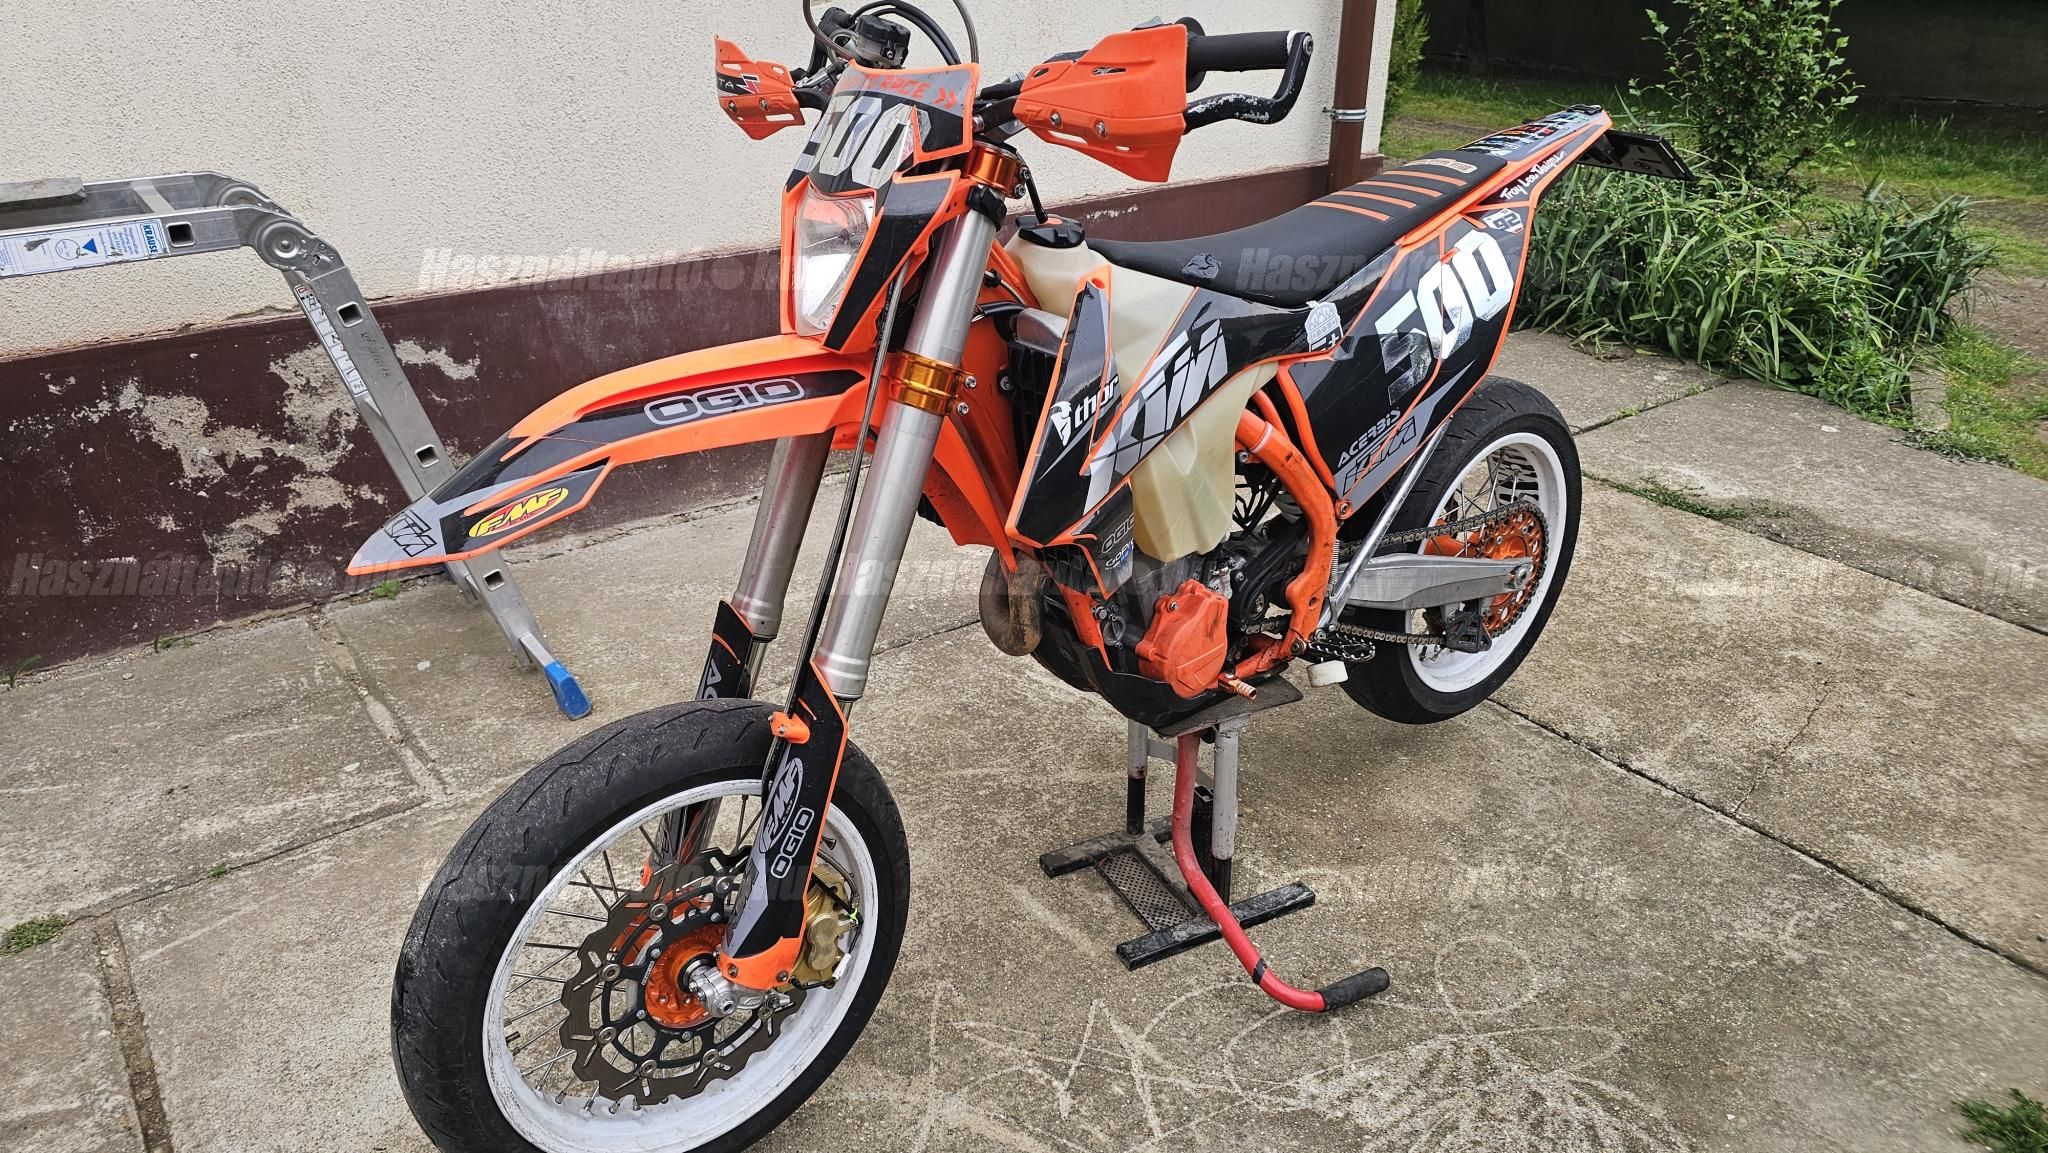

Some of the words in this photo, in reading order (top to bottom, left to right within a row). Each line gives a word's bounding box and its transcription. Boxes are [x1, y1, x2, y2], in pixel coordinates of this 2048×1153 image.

[1499, 184, 1529, 200] Troy
[143, 224, 157, 254] KRAUSE
[1492, 211, 1522, 230] 92
[1374, 229, 1515, 406] 500
[644, 377, 805, 426] OGIO
[1074, 374, 1120, 430] thor
[474, 487, 564, 538] FMF
[770, 805, 816, 879] OGIO
